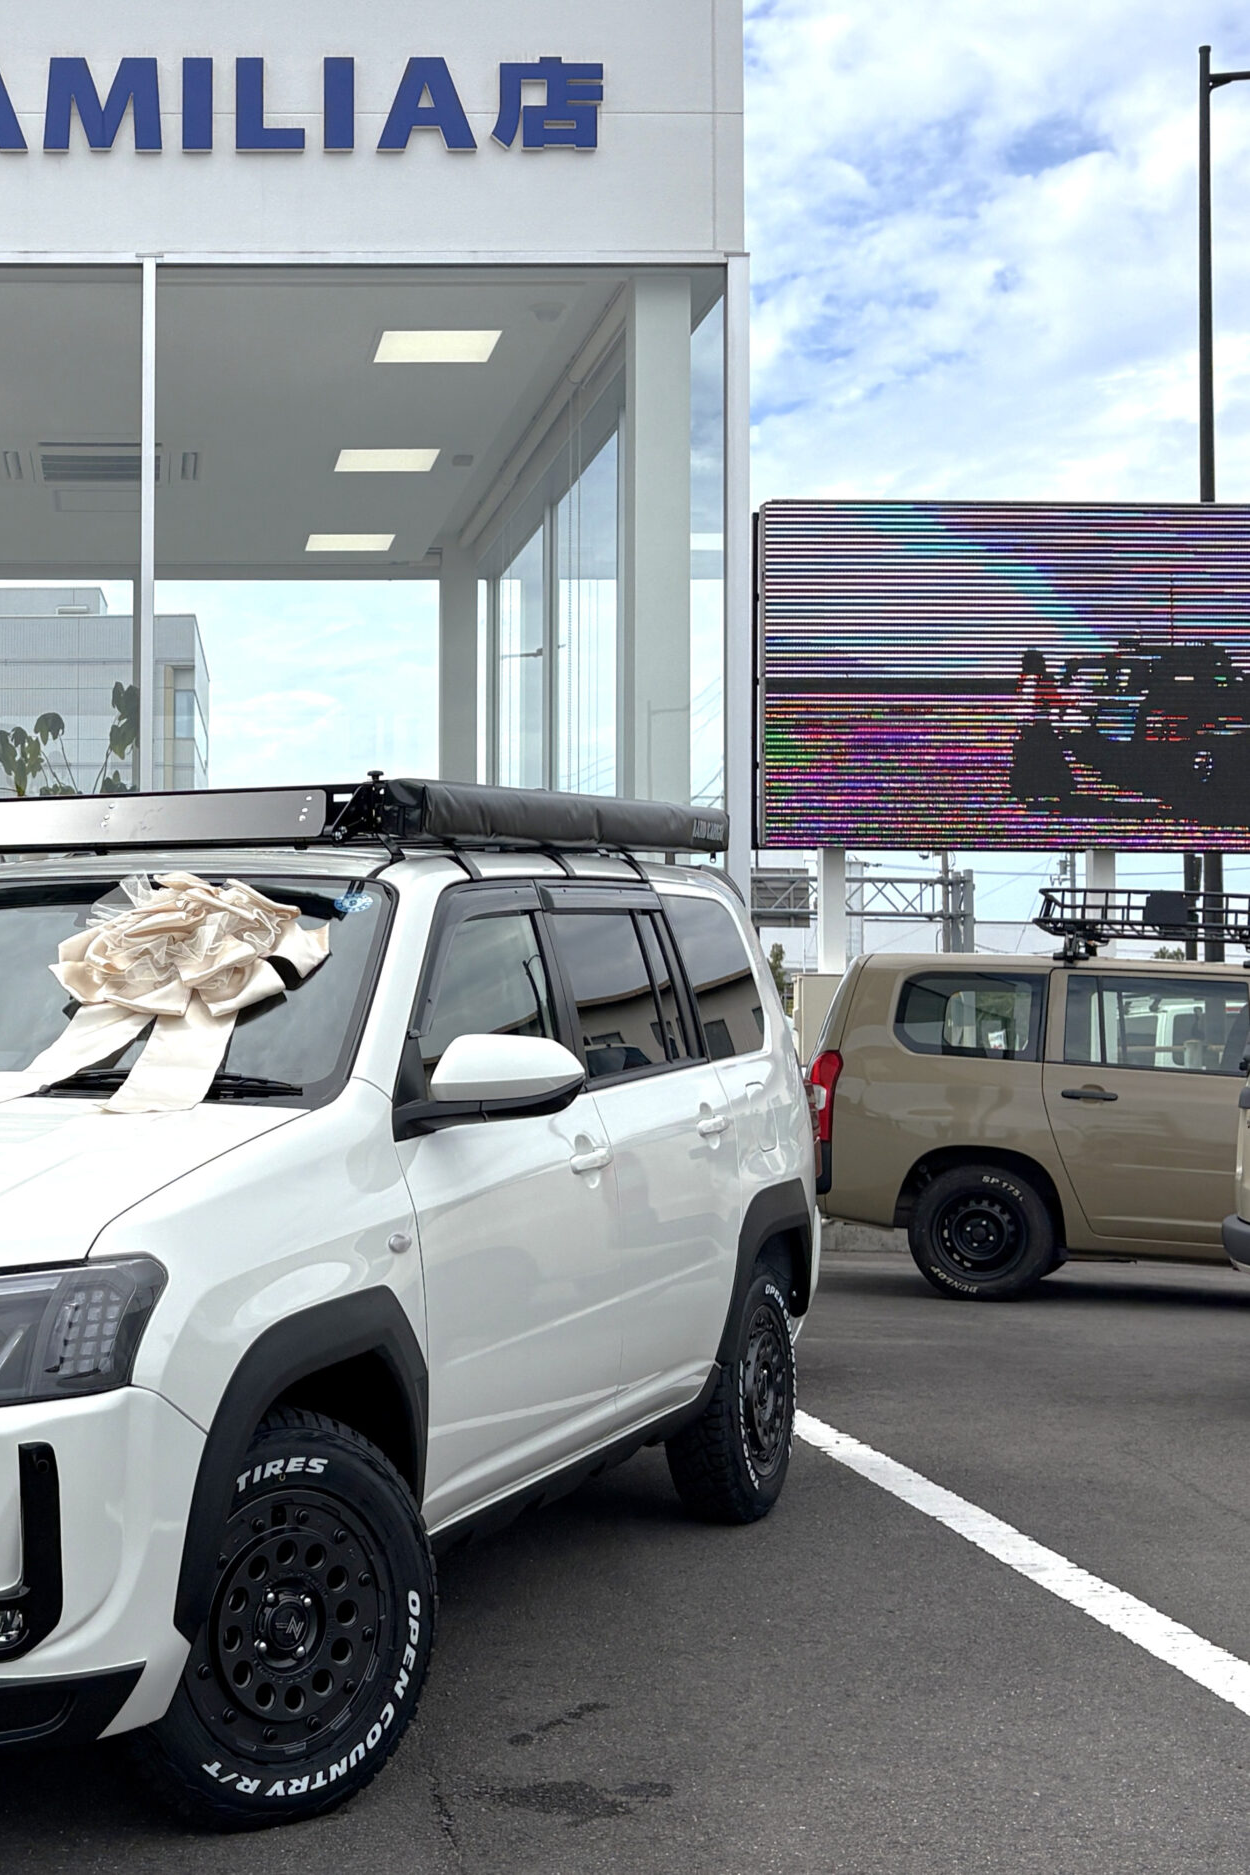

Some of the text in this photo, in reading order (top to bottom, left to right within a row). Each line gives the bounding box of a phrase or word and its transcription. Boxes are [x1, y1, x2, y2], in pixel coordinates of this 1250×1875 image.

[764, 1283, 785, 1308] OPEN
[931, 1265, 980, 1294] DUNLOP
[236, 1456, 329, 1493] TIRES
[202, 1589, 422, 1798] OPEN COUNTRY R/T
